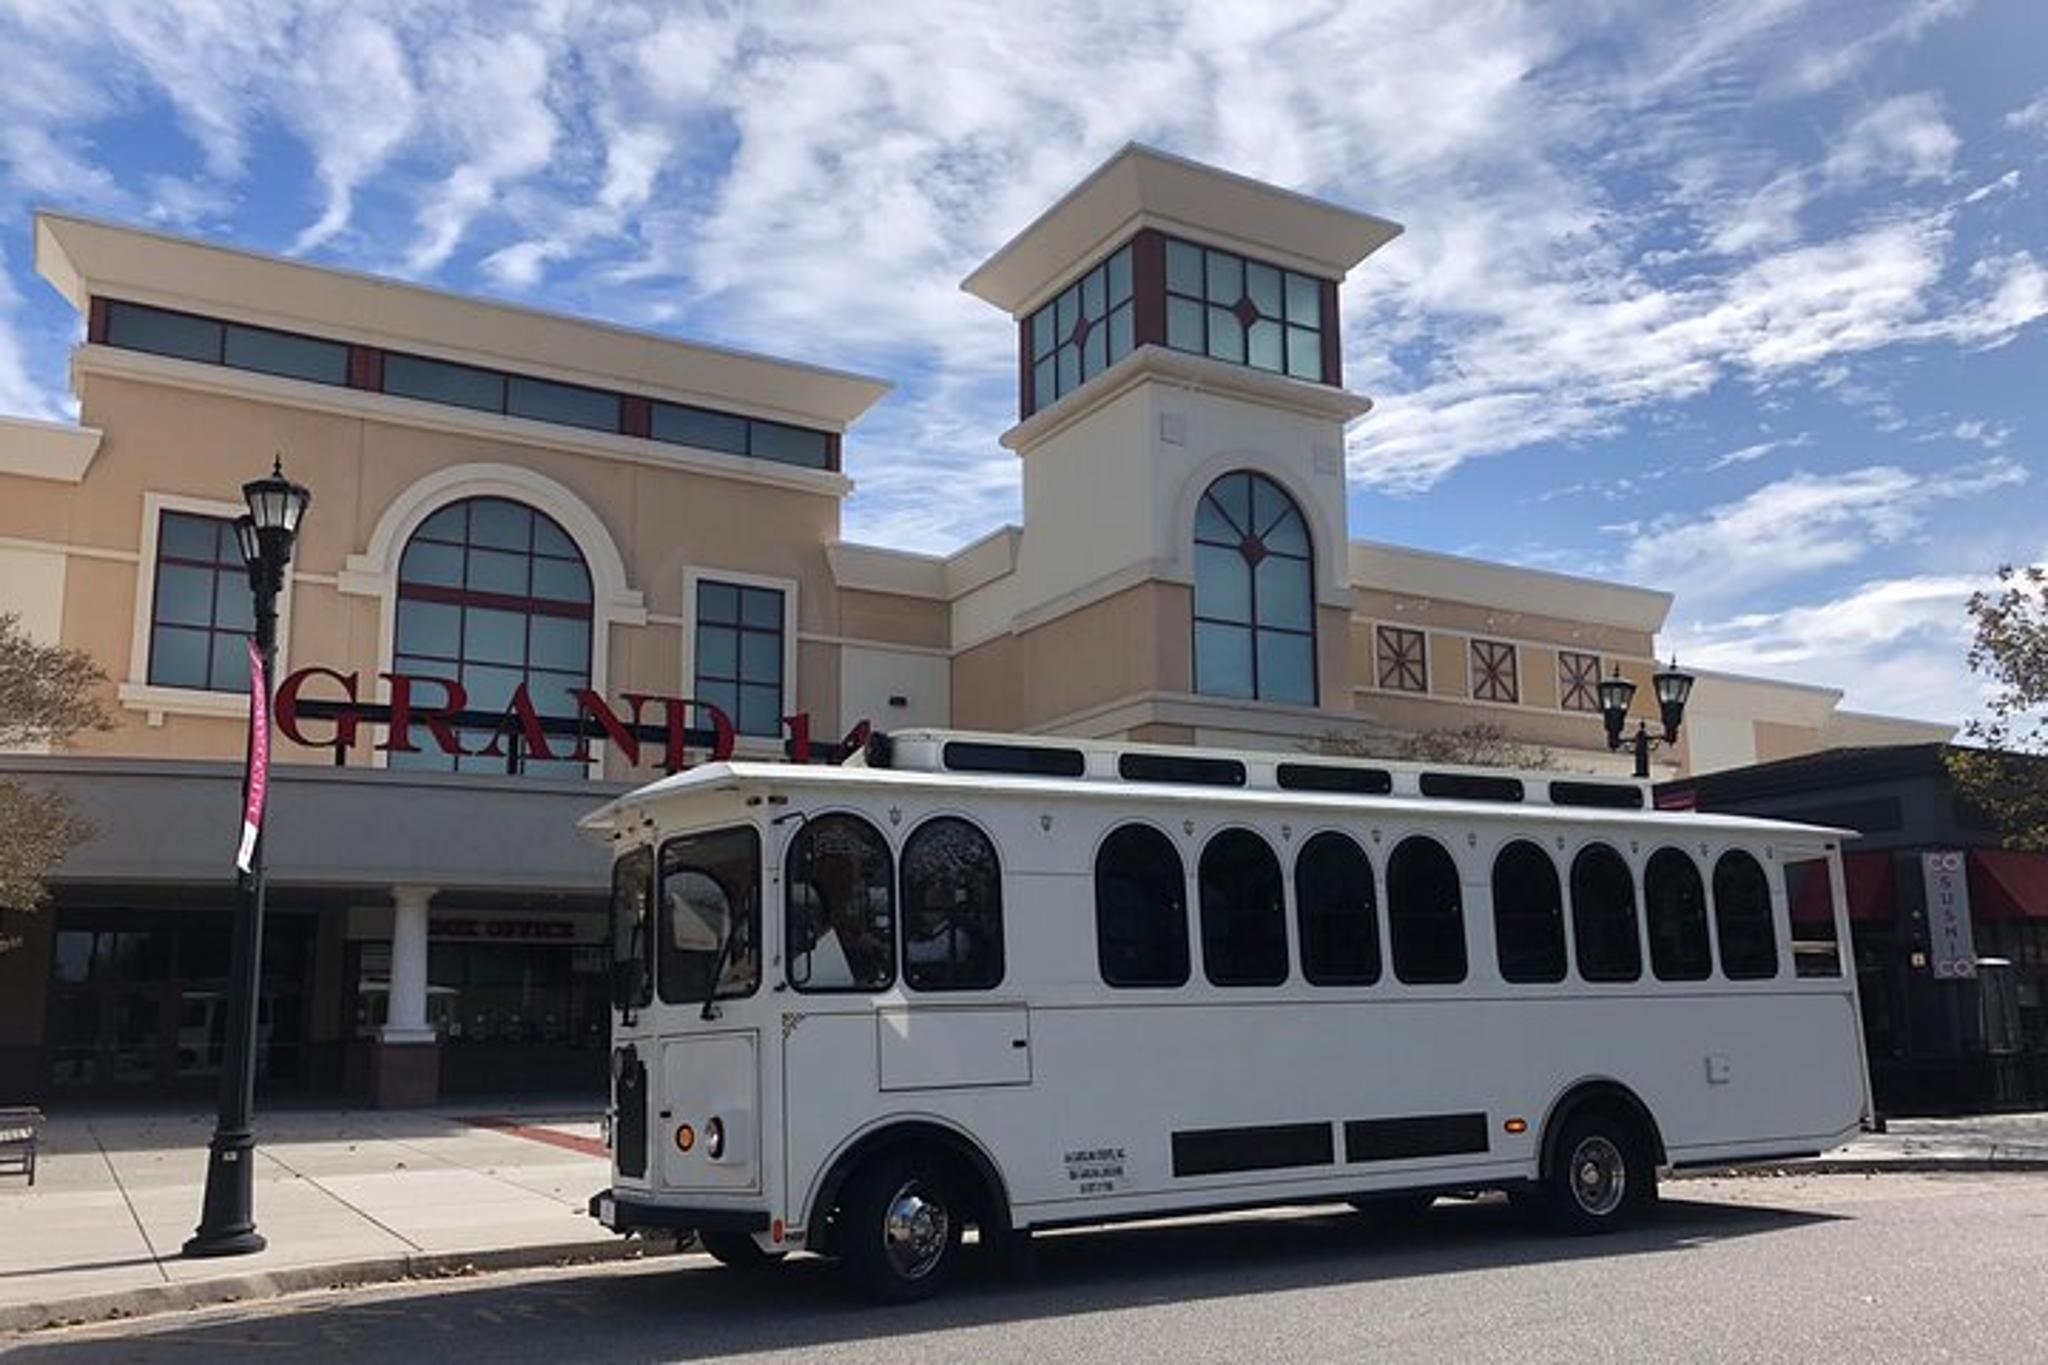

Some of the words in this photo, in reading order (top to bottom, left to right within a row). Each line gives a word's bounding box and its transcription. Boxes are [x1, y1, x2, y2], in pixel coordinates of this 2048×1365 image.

[273, 667, 736, 775] GRAND
[485, 919, 575, 938] OFFICE
[1938, 875, 1958, 955] SUSHI
